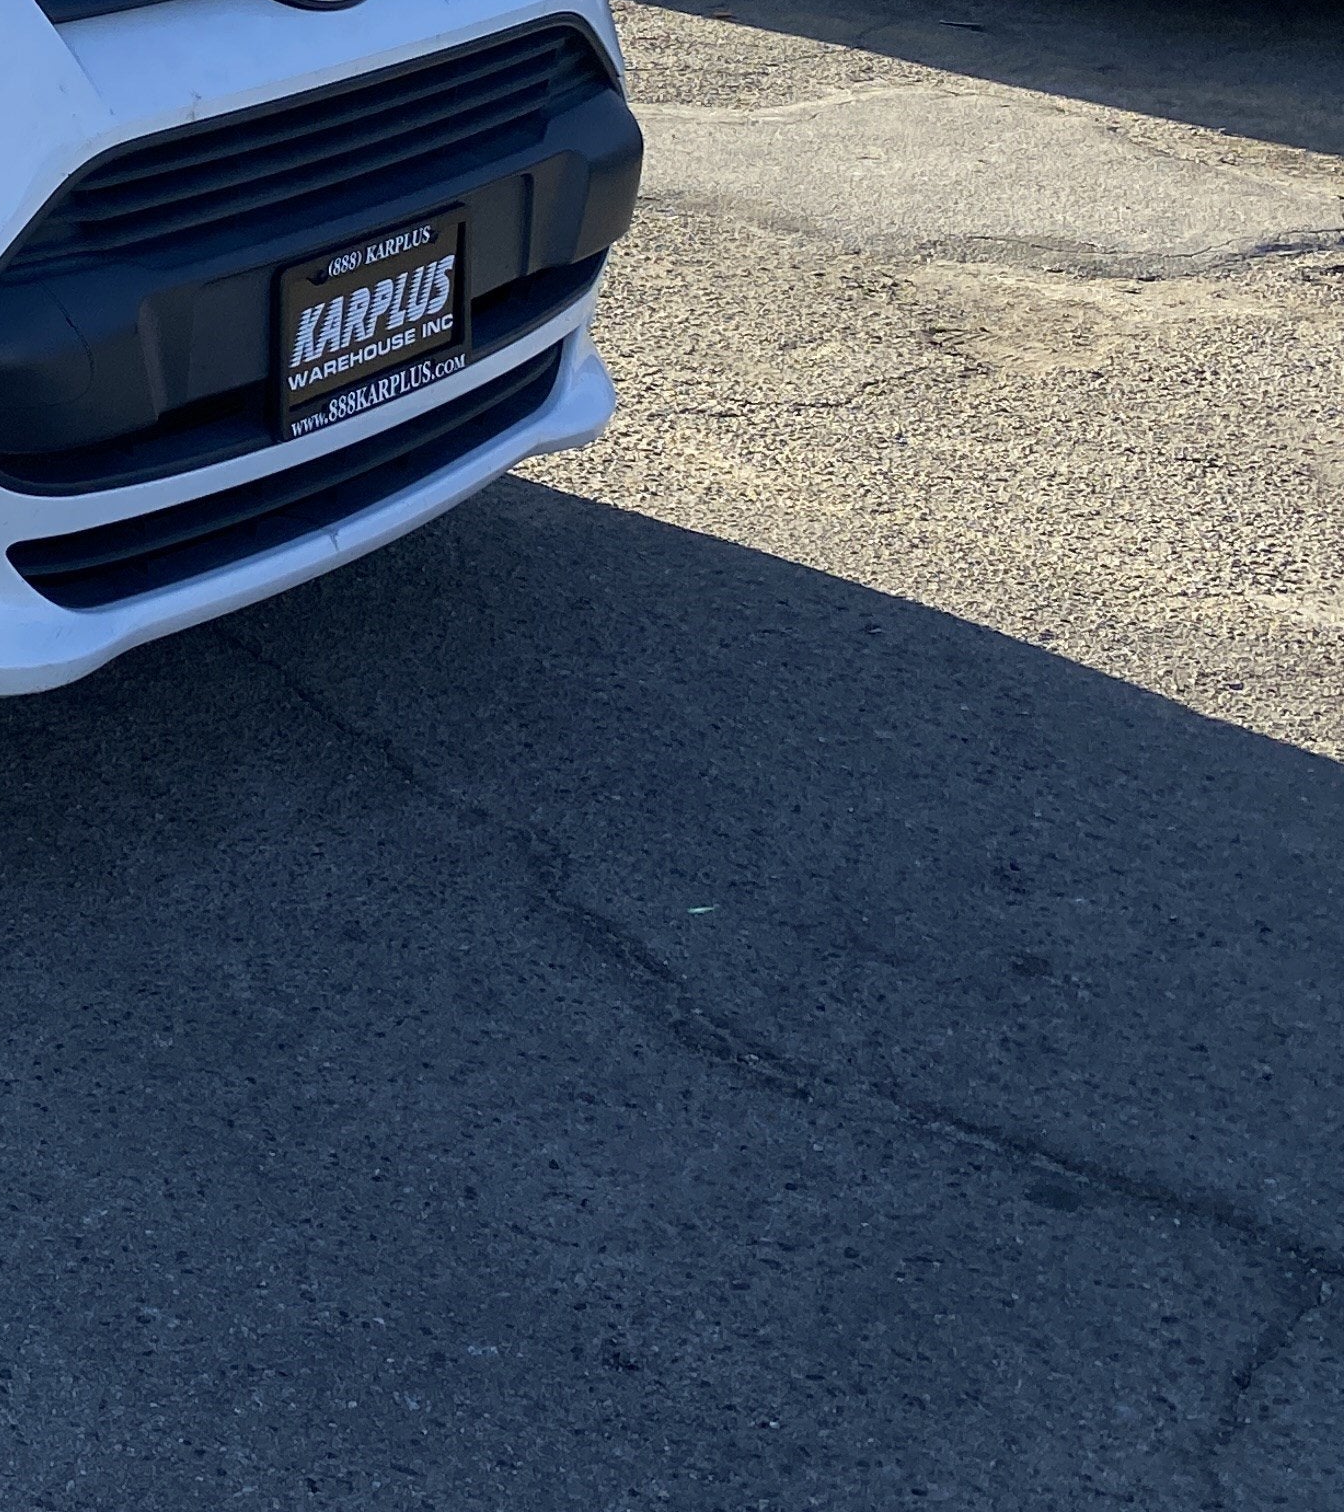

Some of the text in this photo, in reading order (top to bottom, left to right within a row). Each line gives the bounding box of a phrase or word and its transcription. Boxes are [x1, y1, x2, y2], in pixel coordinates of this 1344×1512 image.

[328, 225, 431, 277] (888) KARPLUS
[289, 254, 455, 368] KARPLUS
[288, 314, 453, 390] WAREHOUSE INC
